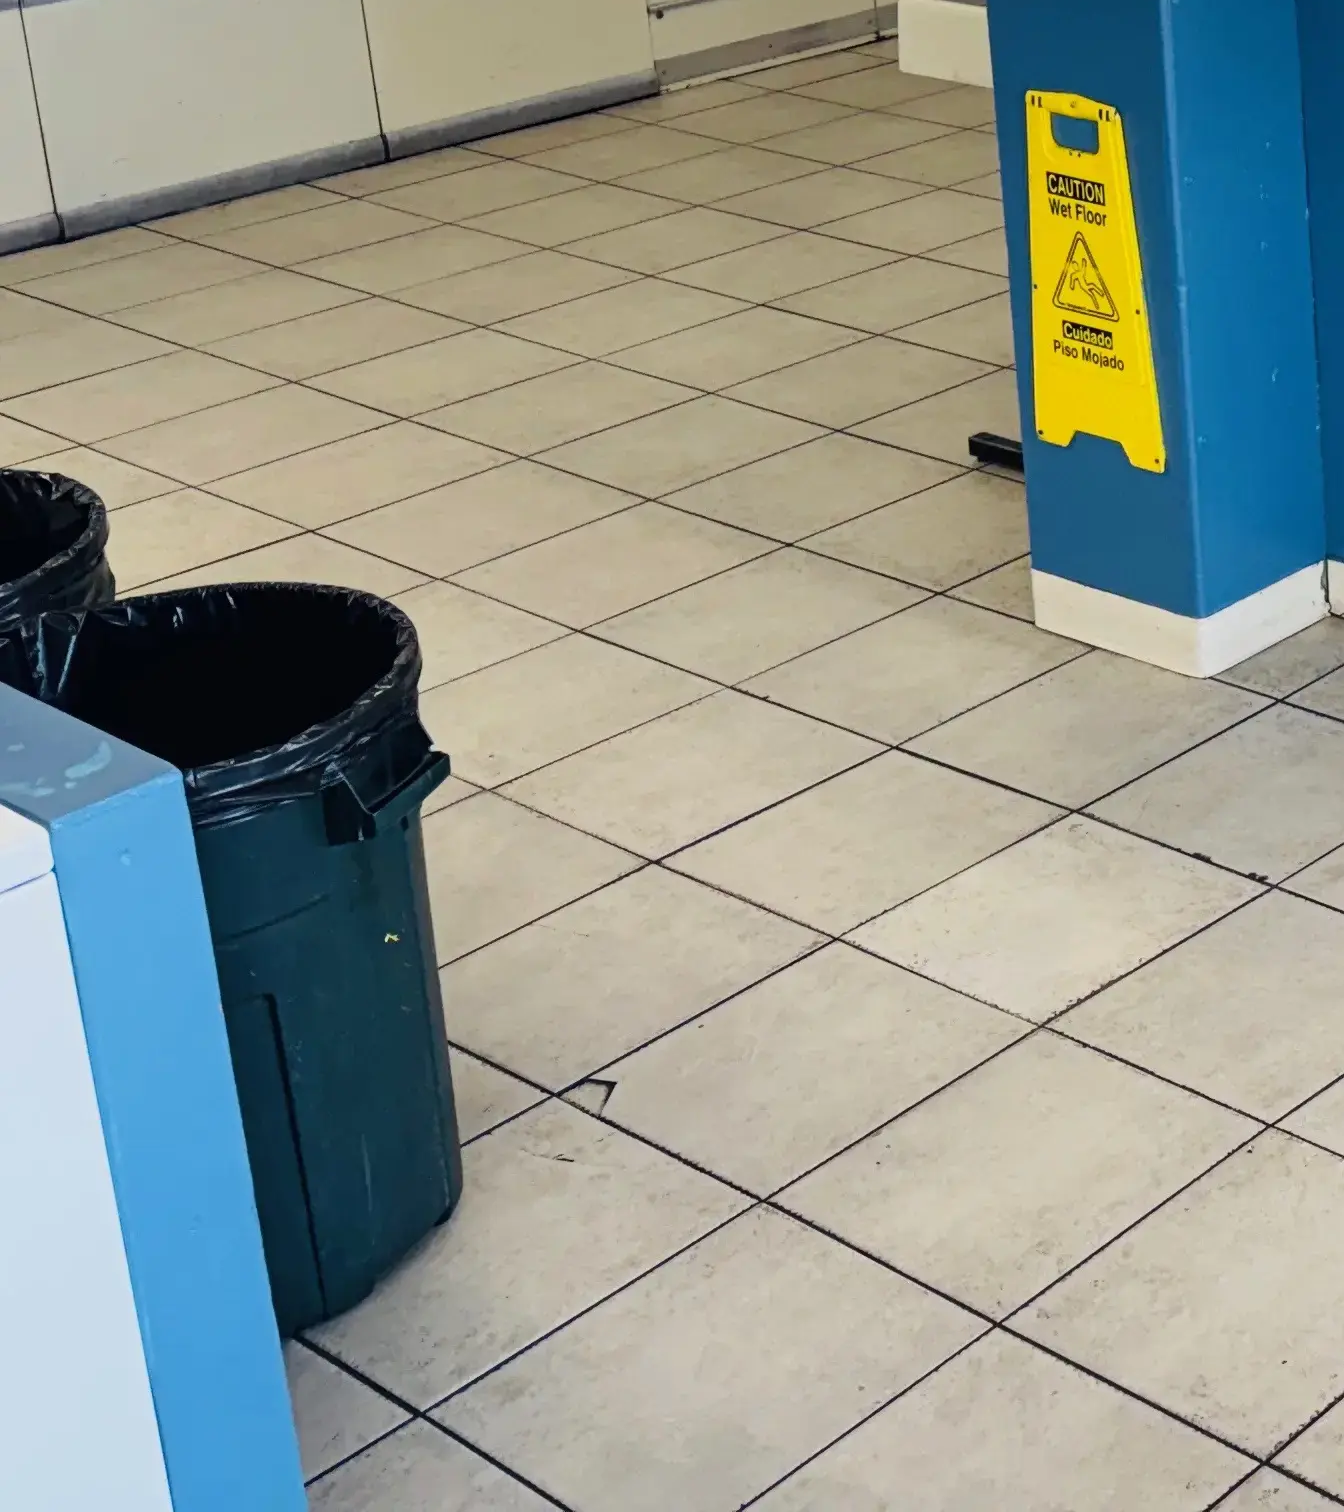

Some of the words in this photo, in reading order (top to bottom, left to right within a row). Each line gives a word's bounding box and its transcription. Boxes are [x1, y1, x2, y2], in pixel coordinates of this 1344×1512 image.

[1047, 173, 1105, 204] CAUTION
[1048, 197, 1072, 219] Wet
[1075, 204, 1107, 227] Floor
[1063, 322, 1113, 349] Cuidado
[1053, 339, 1079, 359] Piso
[1081, 346, 1125, 371] Mojado
